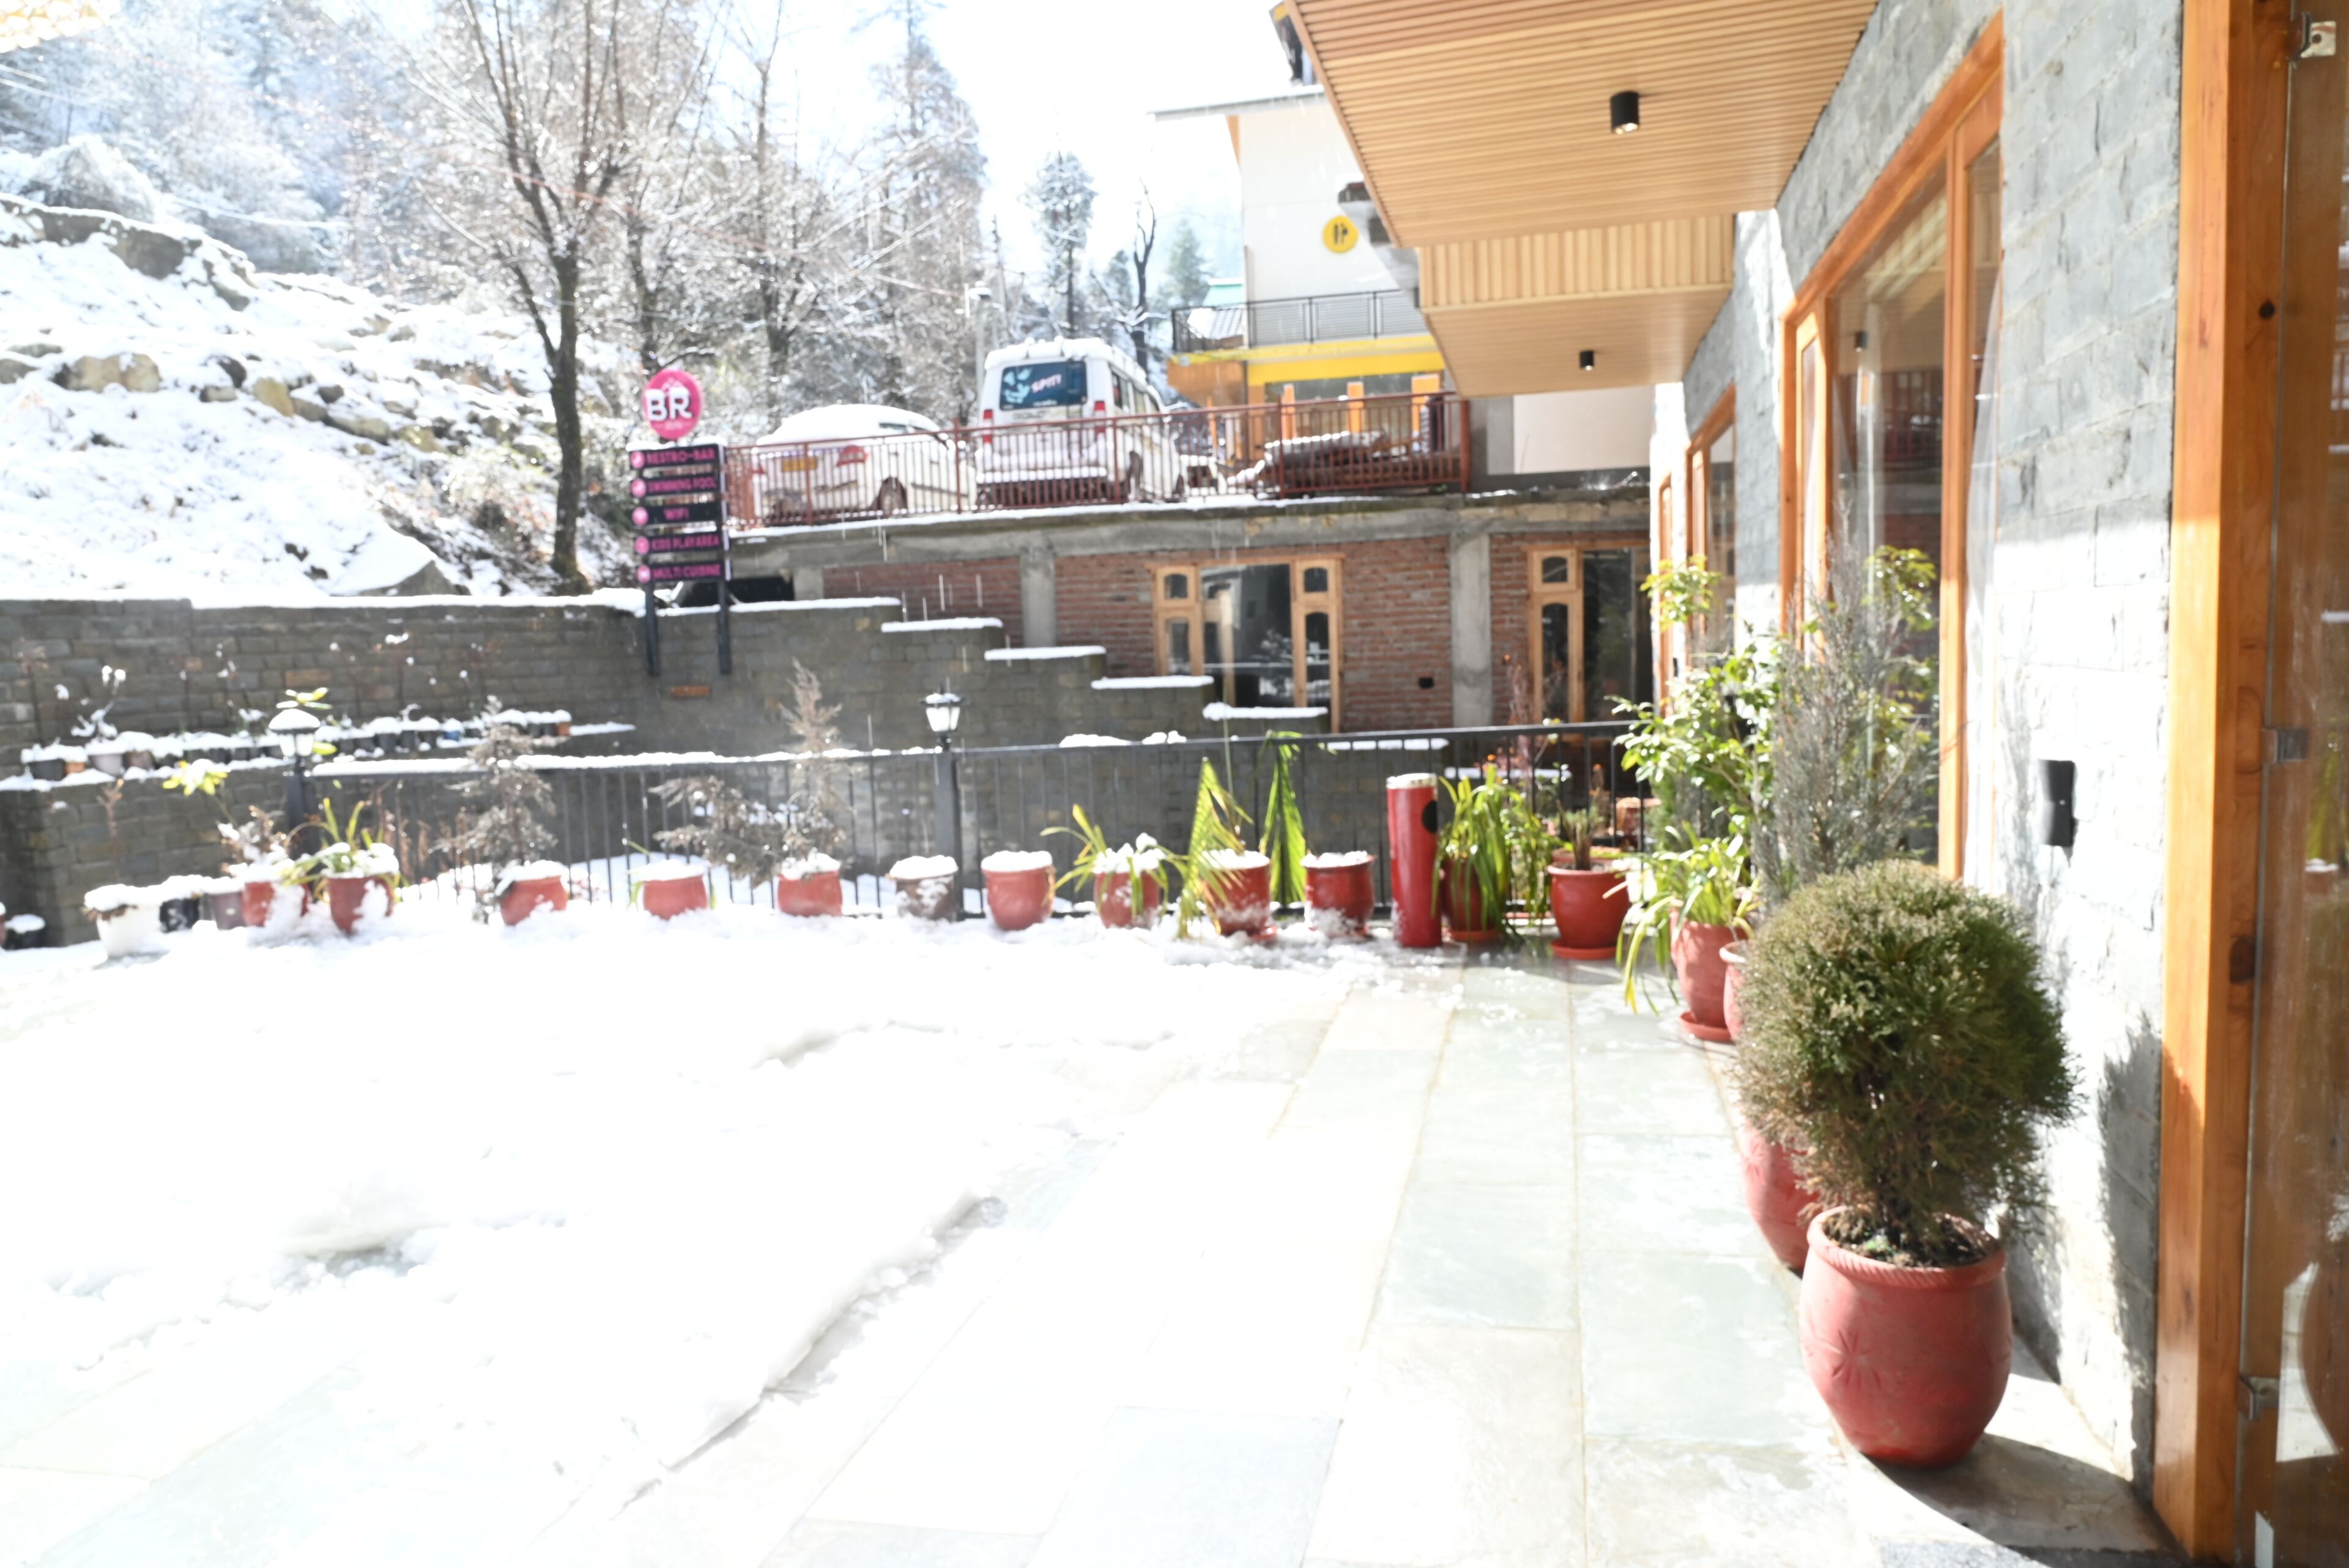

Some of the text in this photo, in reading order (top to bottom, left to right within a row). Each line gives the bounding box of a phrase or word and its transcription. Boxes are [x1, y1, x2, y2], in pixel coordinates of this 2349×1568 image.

[645, 388, 692, 421] BR
[649, 477, 716, 493] SWIMMING POOL
[663, 508, 689, 521] WIFI
[651, 538, 671, 551] KIDS
[653, 563, 721, 579] MULTI CUISINE
